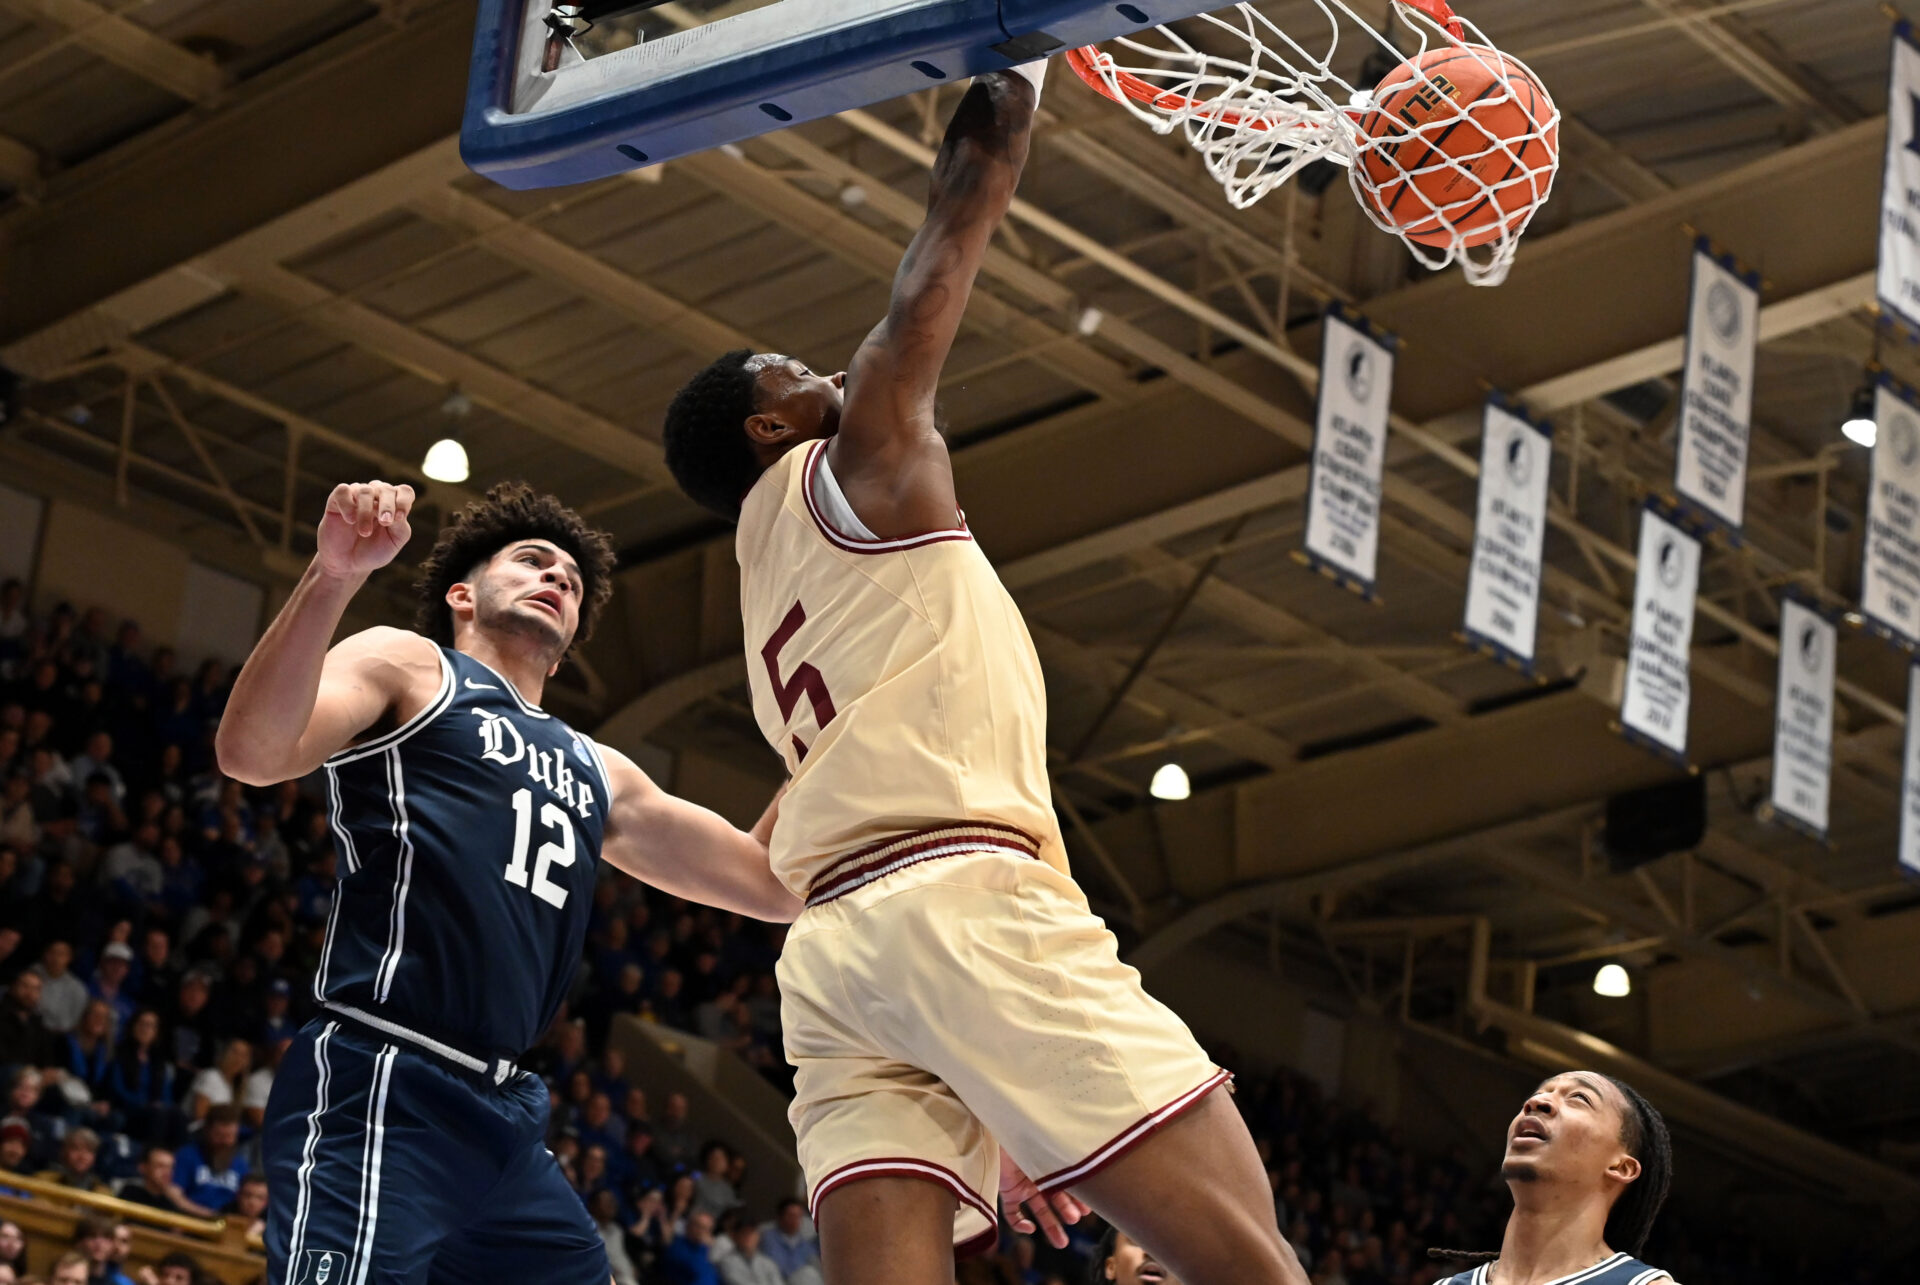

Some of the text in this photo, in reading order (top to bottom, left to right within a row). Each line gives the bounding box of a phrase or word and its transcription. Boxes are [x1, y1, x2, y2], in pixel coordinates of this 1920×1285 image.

[761, 599, 837, 764] 5
[471, 707, 594, 818] Duke
[504, 787, 576, 910] 12
